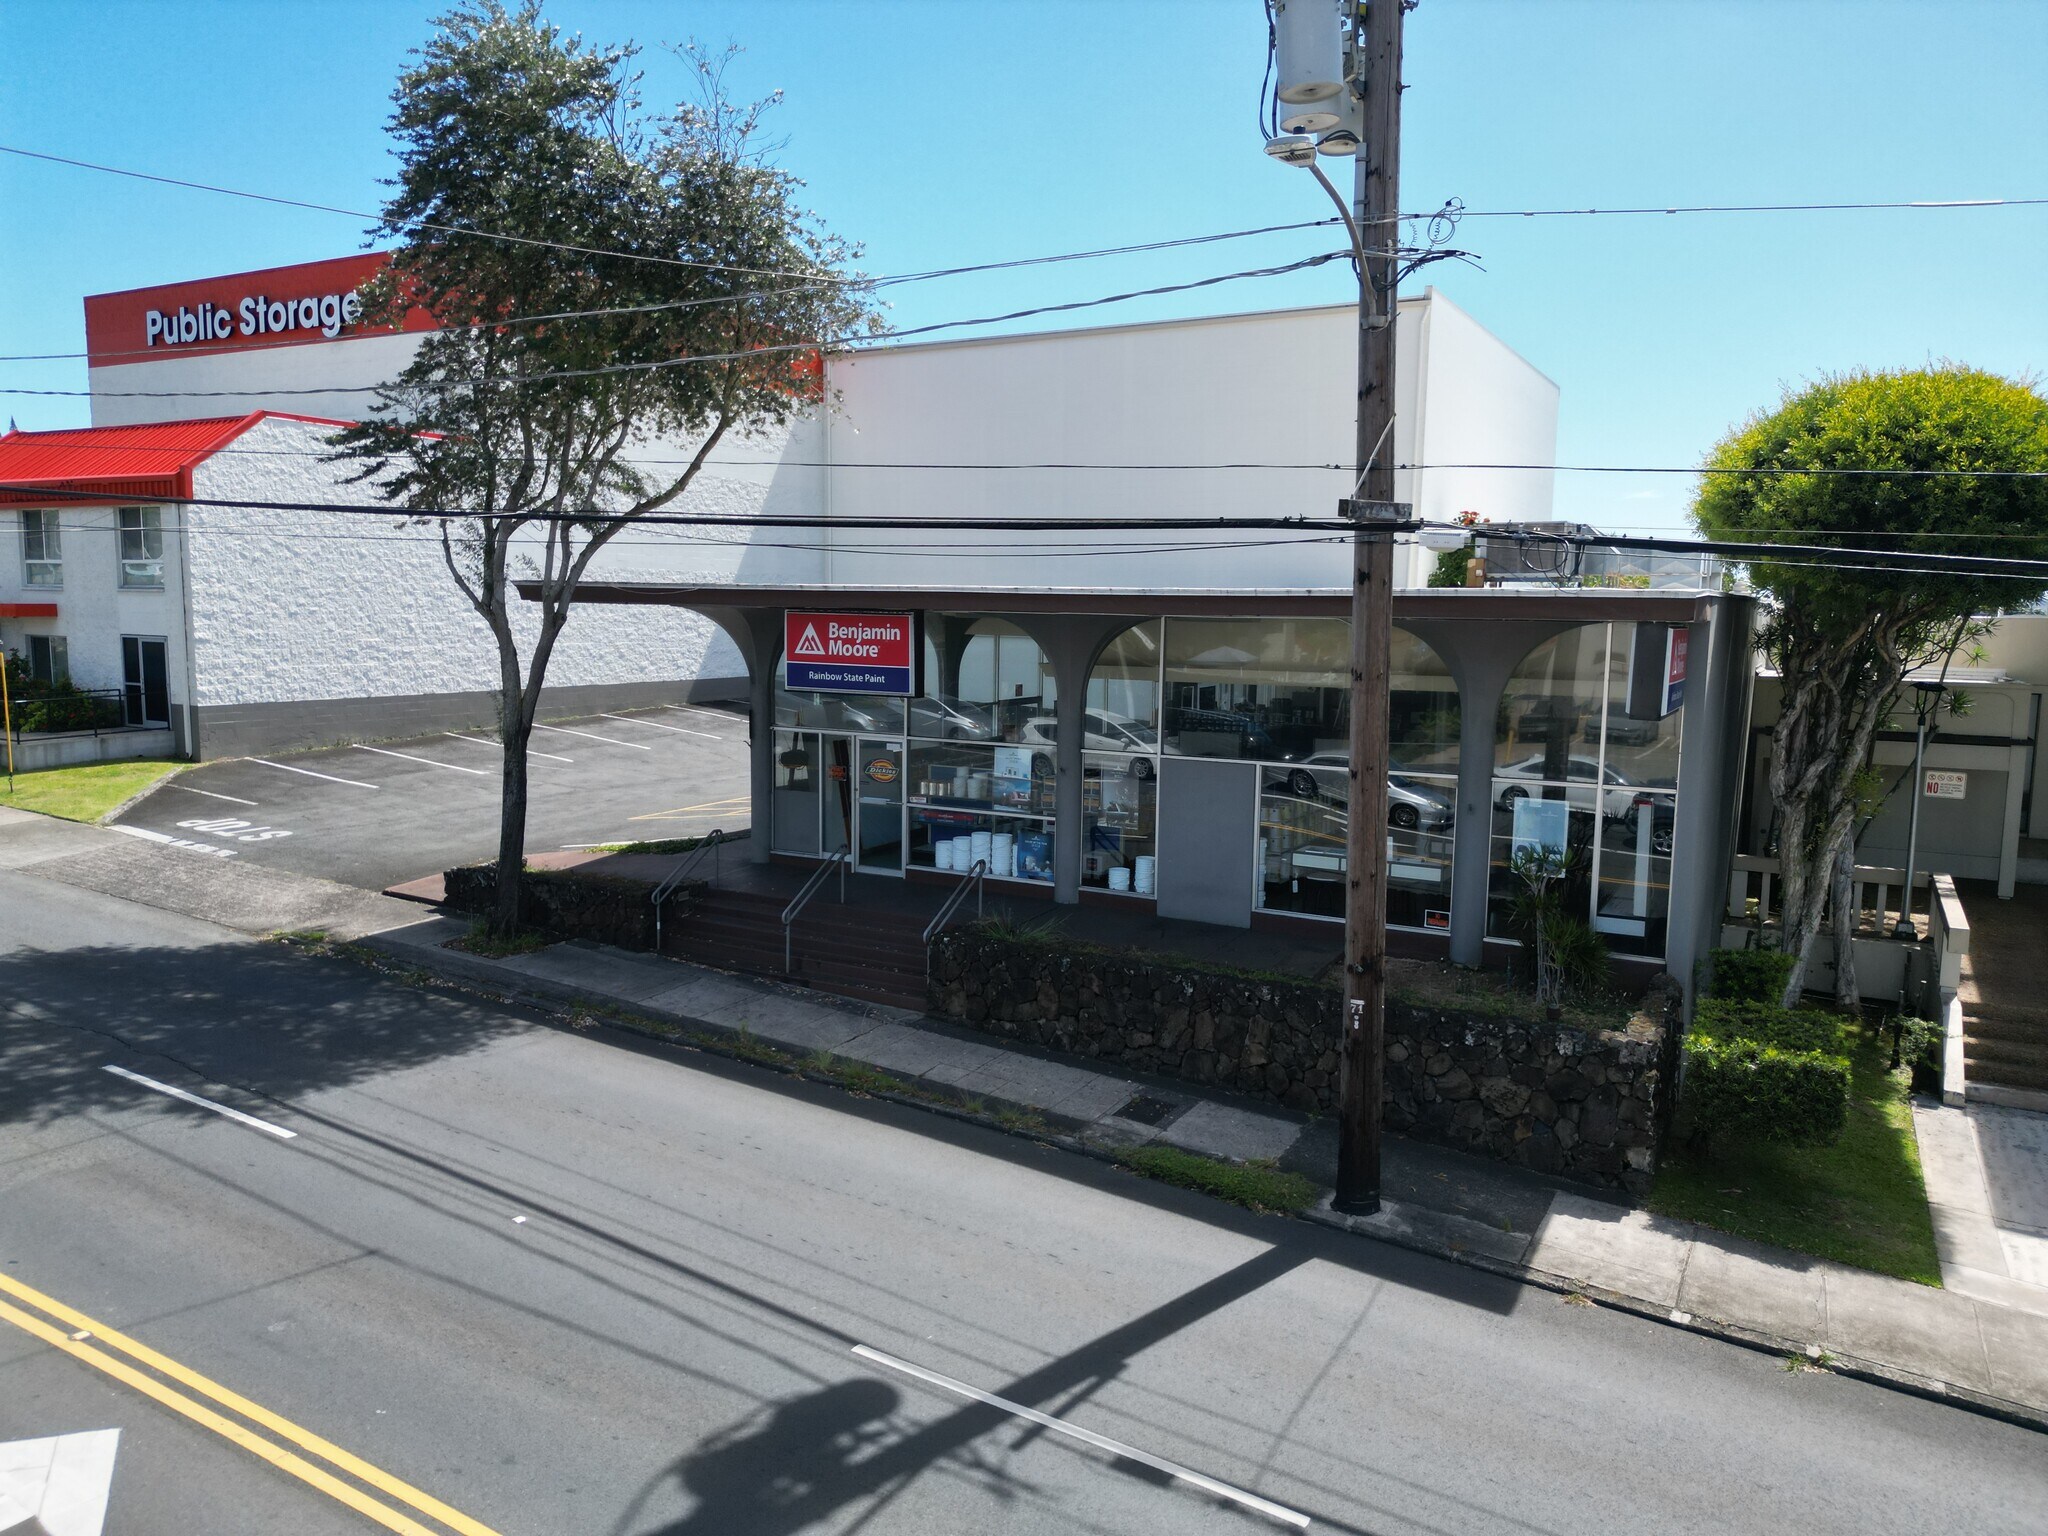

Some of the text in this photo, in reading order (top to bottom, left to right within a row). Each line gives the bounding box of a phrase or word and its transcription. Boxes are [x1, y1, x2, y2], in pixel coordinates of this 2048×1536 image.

[146, 292, 362, 346] Public Storage
[828, 622, 901, 643] Benjamin
[828, 640, 879, 657] Moore
[809, 671, 885, 684] Rainbow State Paint
[869, 767, 896, 775] Dickies
[1927, 782, 1939, 794] NO
[176, 818, 293, 841] STOP
[1350, 1004, 1363, 1014] 71
